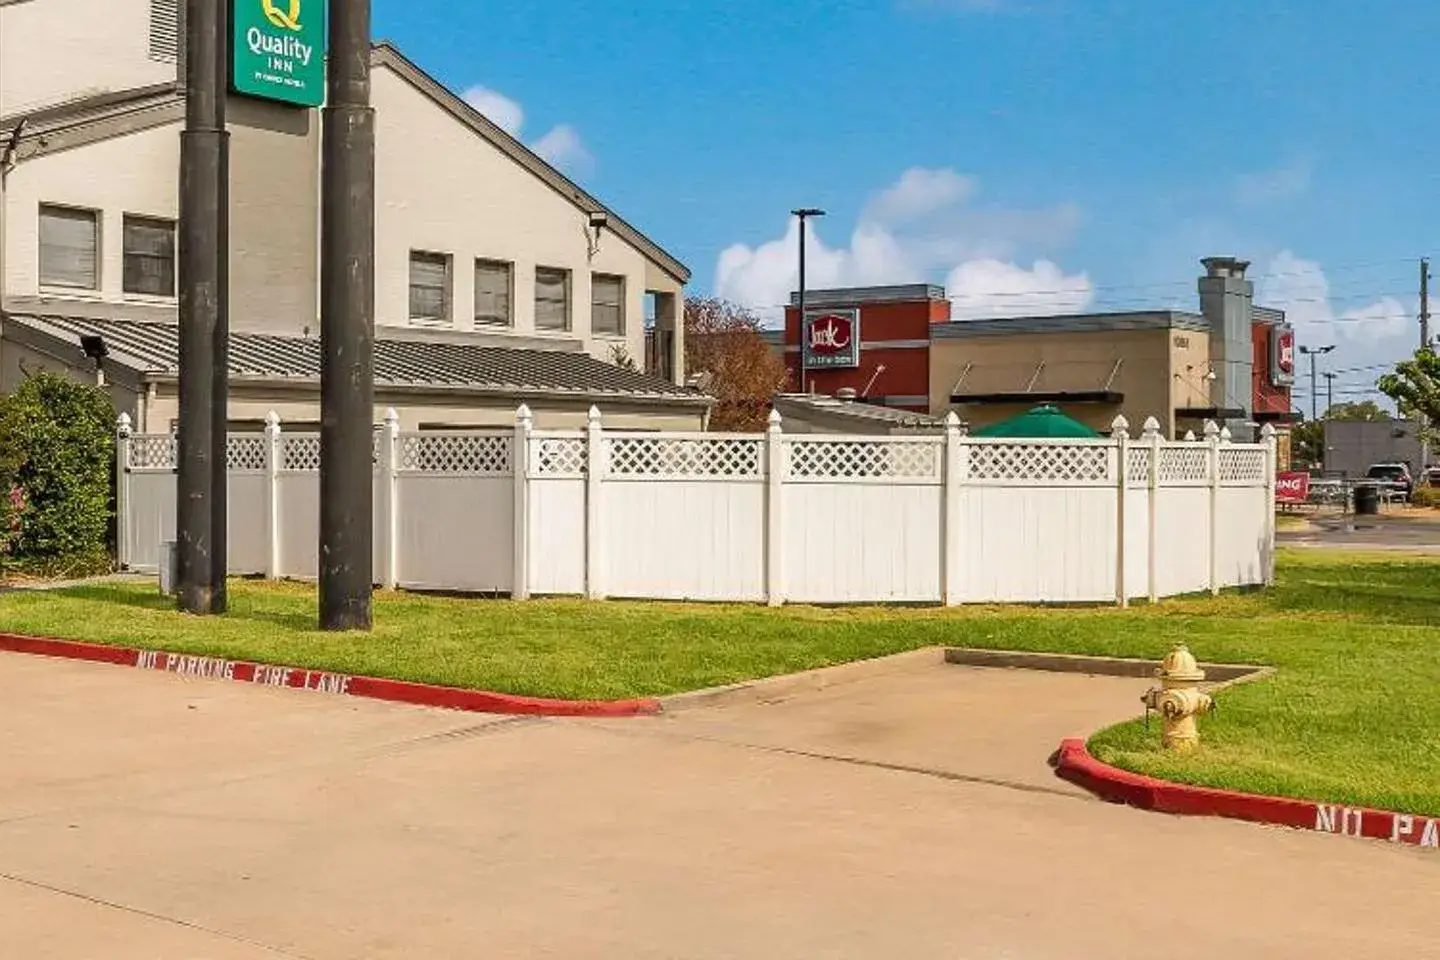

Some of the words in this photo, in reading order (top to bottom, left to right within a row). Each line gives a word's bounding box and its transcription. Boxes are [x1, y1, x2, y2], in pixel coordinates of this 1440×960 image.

[247, 26, 312, 66] Quality
[267, 56, 293, 74] INN
[136, 650, 158, 670] NO
[166, 654, 235, 680] PARKING
[253, 664, 293, 688] FIRE
[304, 669, 353, 695] LANE
[1316, 804, 1362, 836] NO
